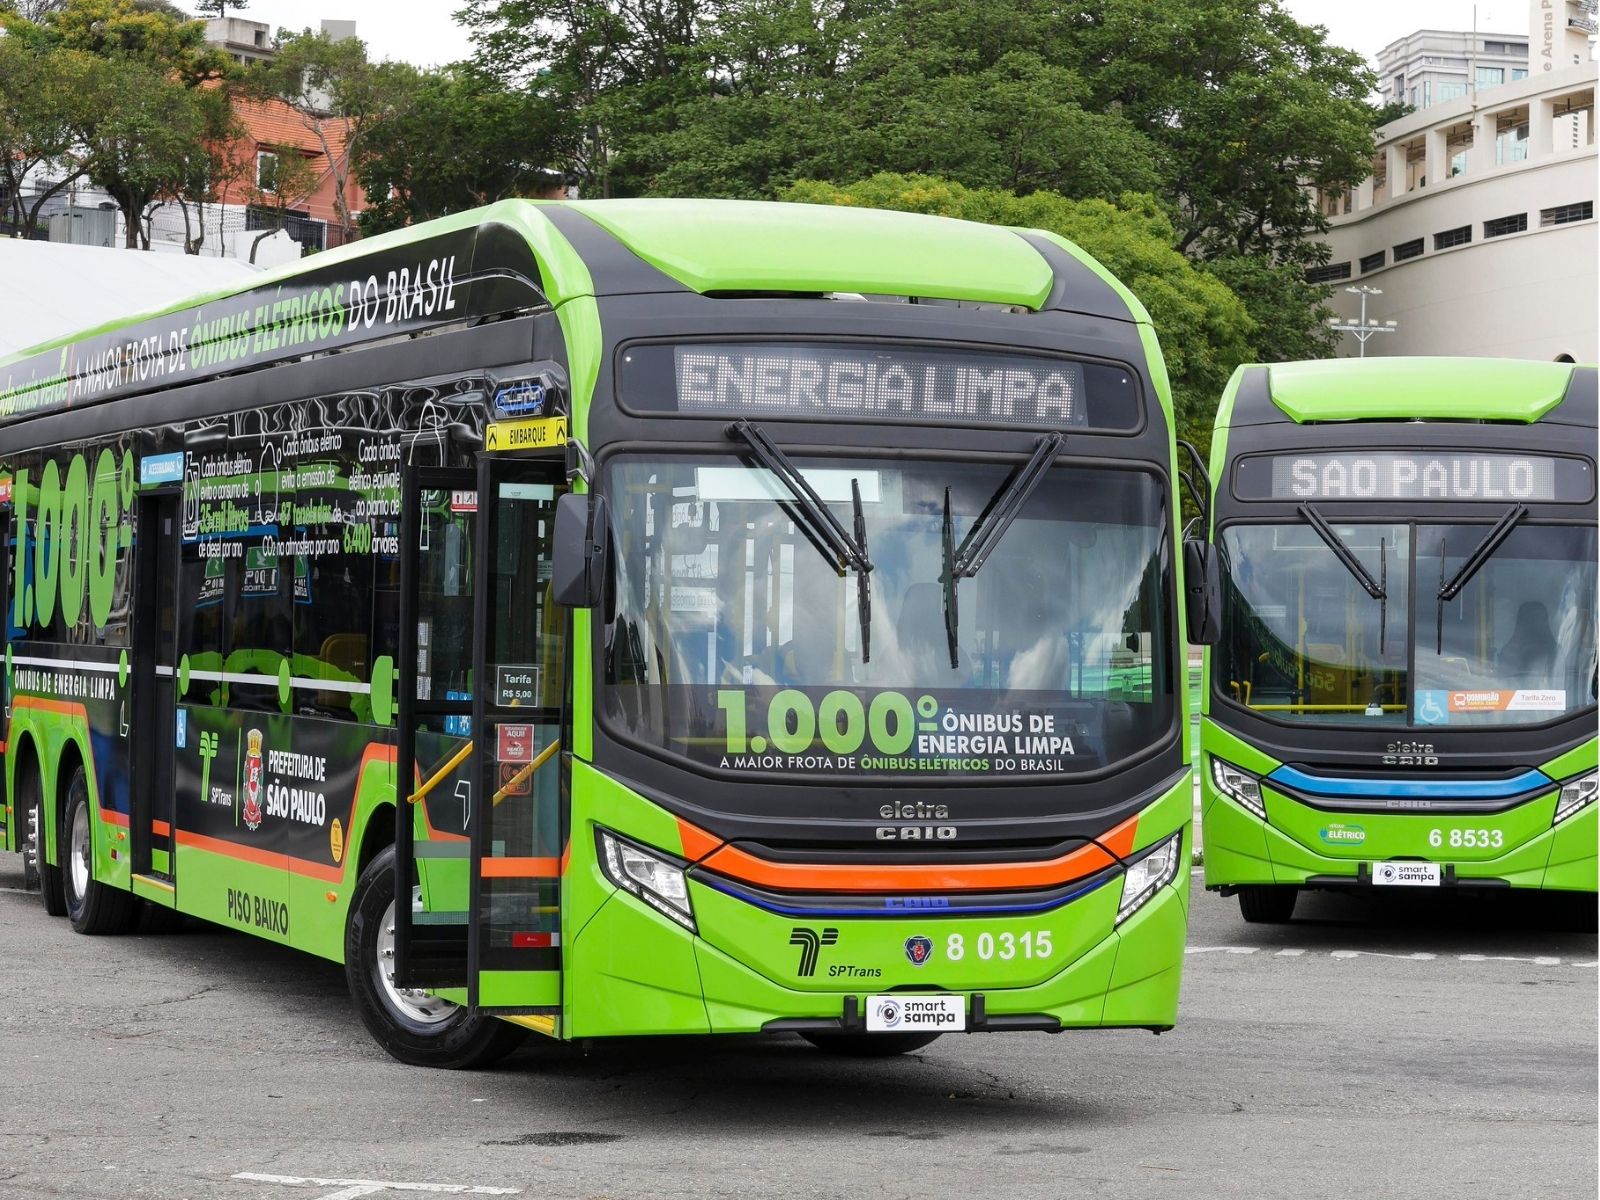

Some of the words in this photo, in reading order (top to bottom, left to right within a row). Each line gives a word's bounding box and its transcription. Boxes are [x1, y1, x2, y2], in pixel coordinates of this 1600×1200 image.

[1541, 12, 1552, 58] Arena
[73, 357, 82, 397] A
[84, 346, 123, 395] MAIOR
[125, 335, 165, 385] FROTA
[168, 328, 188, 374] DE
[190, 310, 250, 368] ÔNIBUS
[253, 282, 346, 356] ELÉTRICOS
[347, 279, 378, 332] DO
[385, 255, 456, 323] BRASIL
[682, 353, 913, 411] ENERGIA
[926, 366, 1073, 419] LIMPA
[282, 434, 299, 457] Cada
[300, 432, 319, 454] ônibus
[320, 428, 342, 451] elétrico
[509, 426, 546, 446] EMBARQUE
[358, 437, 377, 462] Cada
[379, 434, 401, 461] ônibus
[201, 455, 216, 477] Cada
[281, 469, 295, 489] evita
[302, 466, 325, 487] emissão
[327, 461, 336, 484] de
[242, 476, 249, 498] de
[348, 466, 371, 490] elétrico
[372, 464, 400, 494] equivale
[1393, 459, 1534, 497] PAULO
[200, 503, 211, 534] 35
[227, 500, 249, 534] litros
[281, 502, 291, 526] 87
[356, 500, 365, 516] ao
[366, 492, 388, 522] plantio
[390, 491, 400, 516] de
[199, 537, 206, 558] de
[276, 540, 285, 556] na
[285, 533, 314, 556] atmosfera
[315, 539, 326, 560] por
[327, 539, 339, 555] ano
[344, 523, 371, 554] 6.400
[371, 532, 399, 554] árvores
[14, 665, 40, 691] ÔNIBUS
[42, 673, 51, 693] DE
[54, 674, 87, 697] ENERGIA
[90, 676, 115, 700] LIMPA
[504, 673, 532, 684] Tarifa
[502, 689, 514, 699] R$
[515, 690, 532, 699] 5,00
[942, 709, 1023, 733] ÔNIBUS
[1029, 715, 1054, 733] DE
[918, 735, 1010, 754] ENERGIA
[1015, 736, 1075, 755] LIMPA
[1386, 741, 1434, 753] eletra
[268, 750, 314, 781] PREFEITURA
[315, 757, 326, 782] DE
[720, 756, 730, 769] A
[734, 756, 783, 769] MAIOR
[788, 756, 833, 769] FROTA
[838, 757, 856, 769] DE
[860, 753, 917, 770] ÔNIBUS
[919, 754, 990, 771] ELÉTRICOS
[995, 758, 1018, 771] DO
[1021, 758, 1064, 771] BRASIL
[1382, 756, 1439, 765] CAIO
[211, 787, 232, 807] SPTrans
[266, 778, 289, 819] SÃO
[290, 787, 326, 826] PAULO
[879, 801, 949, 819] eletra
[875, 826, 957, 840] CAIO
[1328, 829, 1365, 840] ELÉTRICO
[1429, 829, 1442, 847] 6
[1450, 829, 1503, 847] 8533
[1398, 874, 1434, 882] sampa
[227, 888, 250, 924] PISO
[255, 895, 289, 936] BAIXO
[947, 934, 964, 961] 8
[977, 931, 1053, 960] 0315
[828, 965, 882, 977] SPTrans
[904, 1000, 946, 1012] smart
[904, 1013, 955, 1027] sampa
